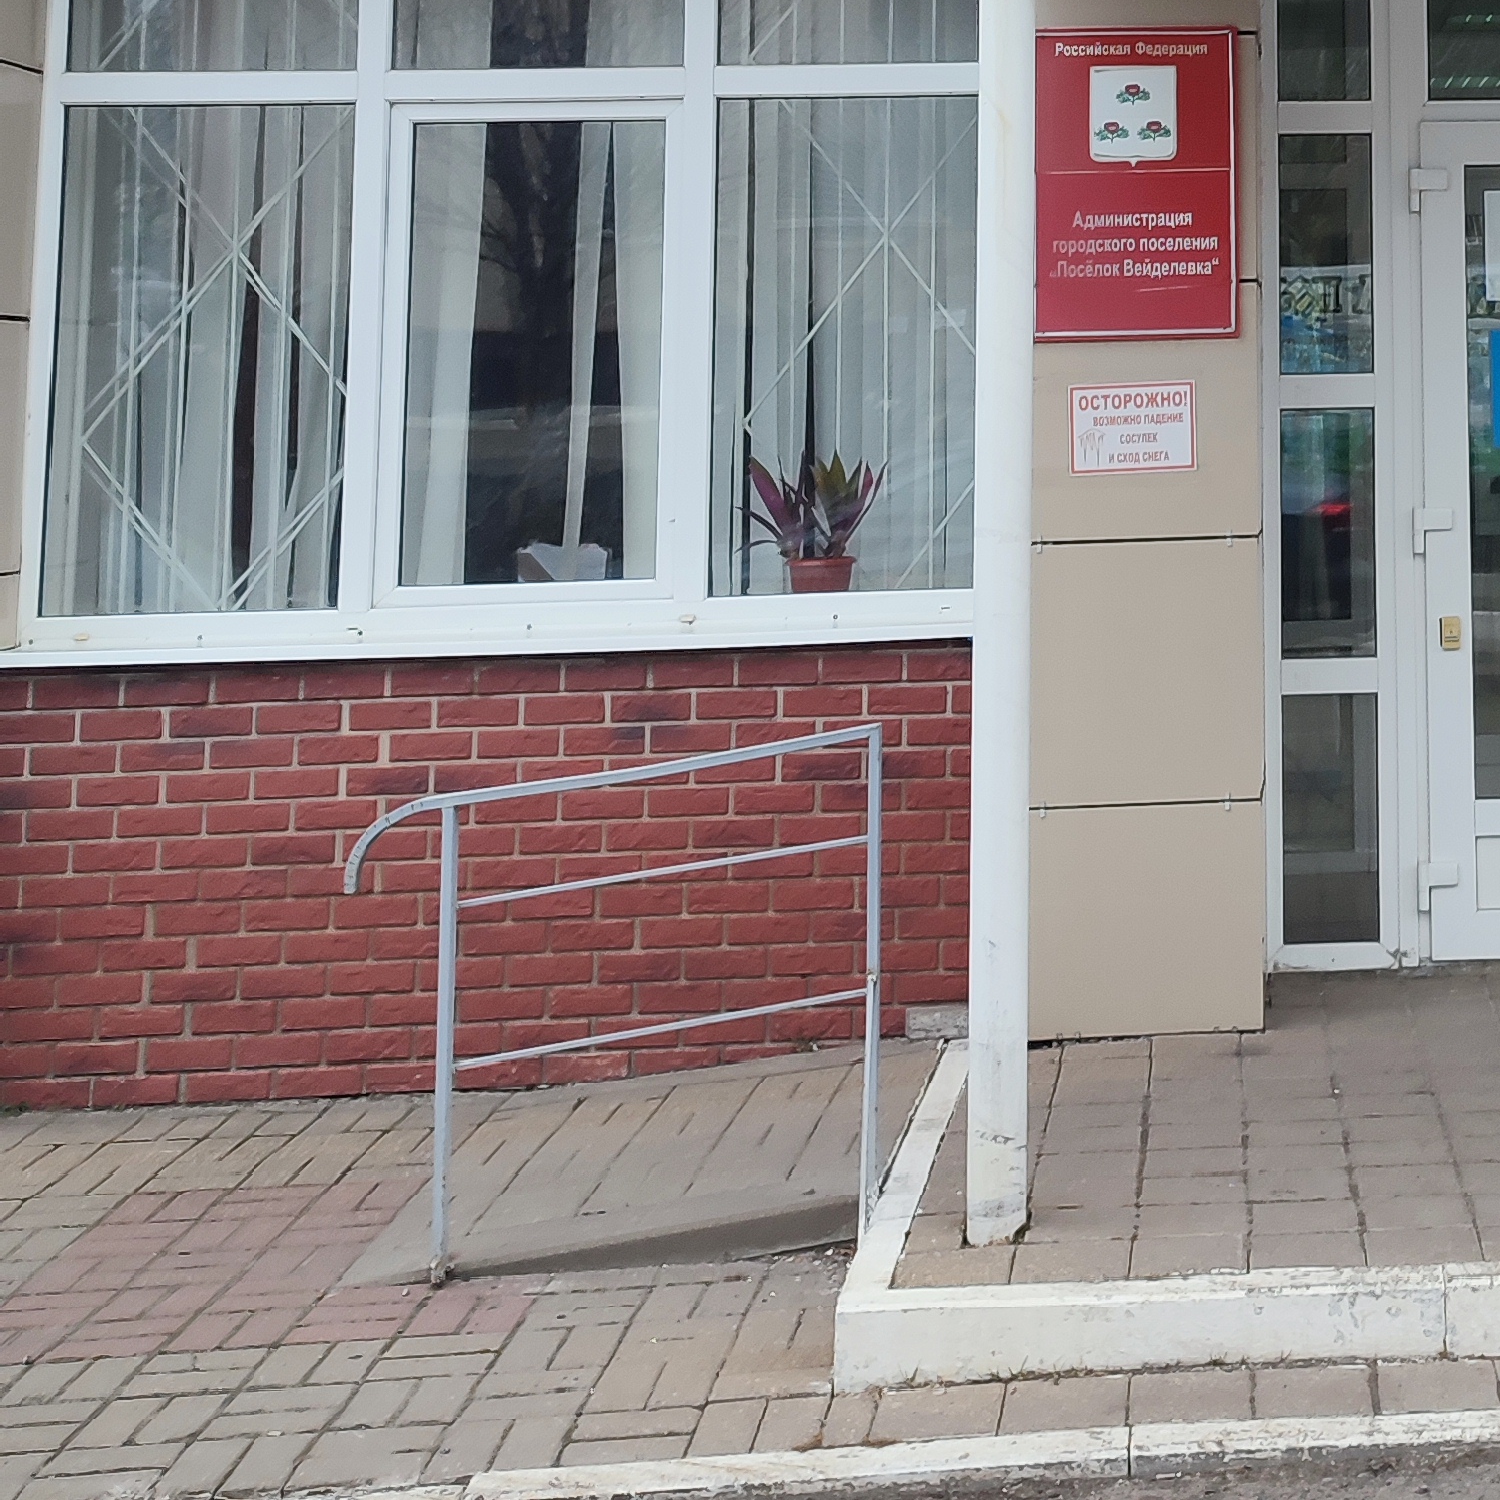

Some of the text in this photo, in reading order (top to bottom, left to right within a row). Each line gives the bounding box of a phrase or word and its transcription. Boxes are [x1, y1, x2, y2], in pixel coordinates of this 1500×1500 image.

[1055, 41, 1208, 57] Российская Федерация
[1072, 210, 1193, 230] Администрация
[1052, 236, 1218, 257] городского поселения
[1078, 390, 1188, 411] ОСТОРОЖНО!
[1092, 412, 1184, 427] ВОЗМОЖНО ПАДЕНИЕ
[1119, 432, 1158, 444] СОСУЛЕК
[1108, 450, 1170, 464] И СХОД СНЕГА
